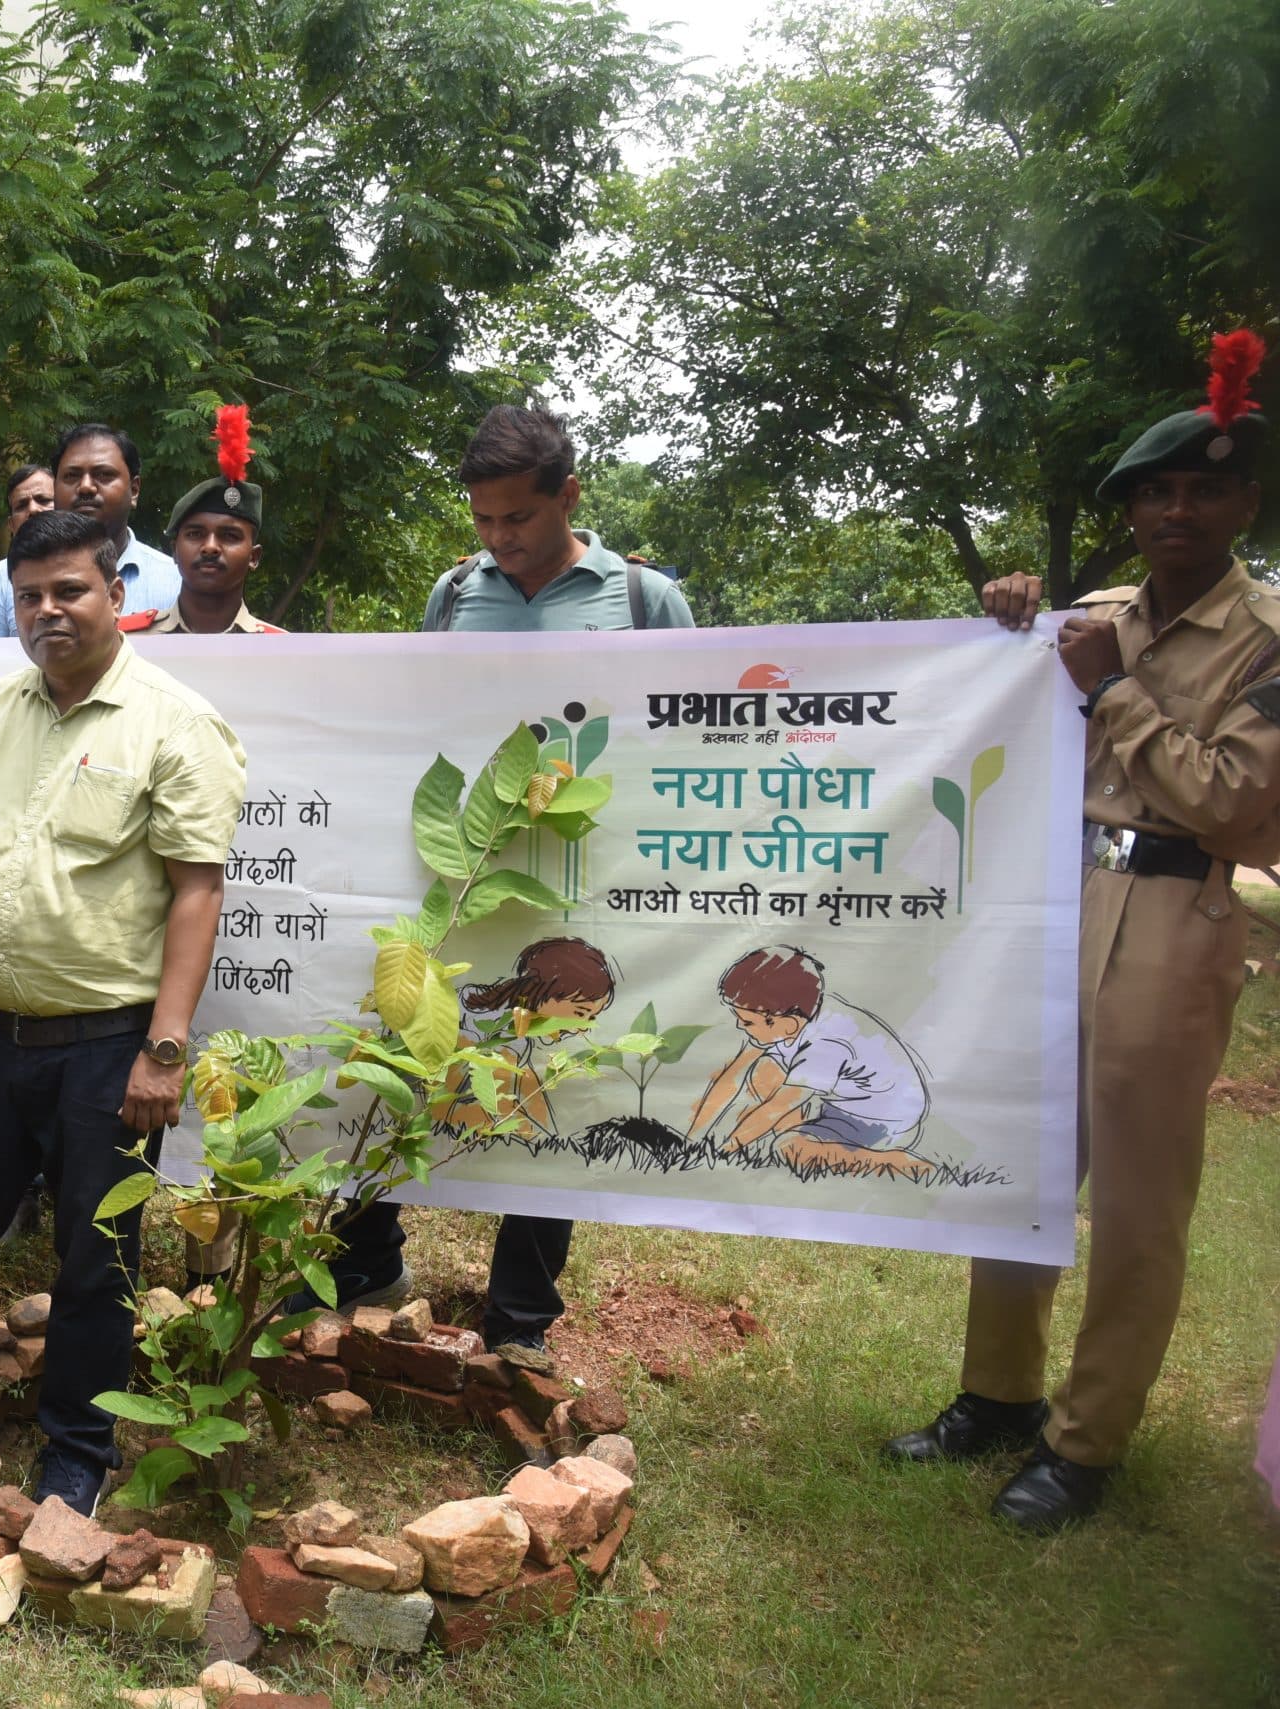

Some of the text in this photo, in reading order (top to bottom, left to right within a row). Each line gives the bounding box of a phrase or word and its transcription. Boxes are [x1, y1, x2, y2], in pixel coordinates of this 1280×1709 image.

[647, 690, 897, 729] प्रभात खबर
[701, 729, 837, 745] अखबार नहीं आंदोलन
[652, 751, 875, 809] नया पौधा
[237, 789, 332, 828] गलों को
[637, 815, 889, 874] नया जीवन
[606, 882, 680, 913] आओ
[690, 883, 761, 916] धरती
[770, 892, 808, 917] का
[900, 886, 947, 919] करें
[274, 902, 328, 941] यारों
[212, 956, 293, 995] जिंदगी
